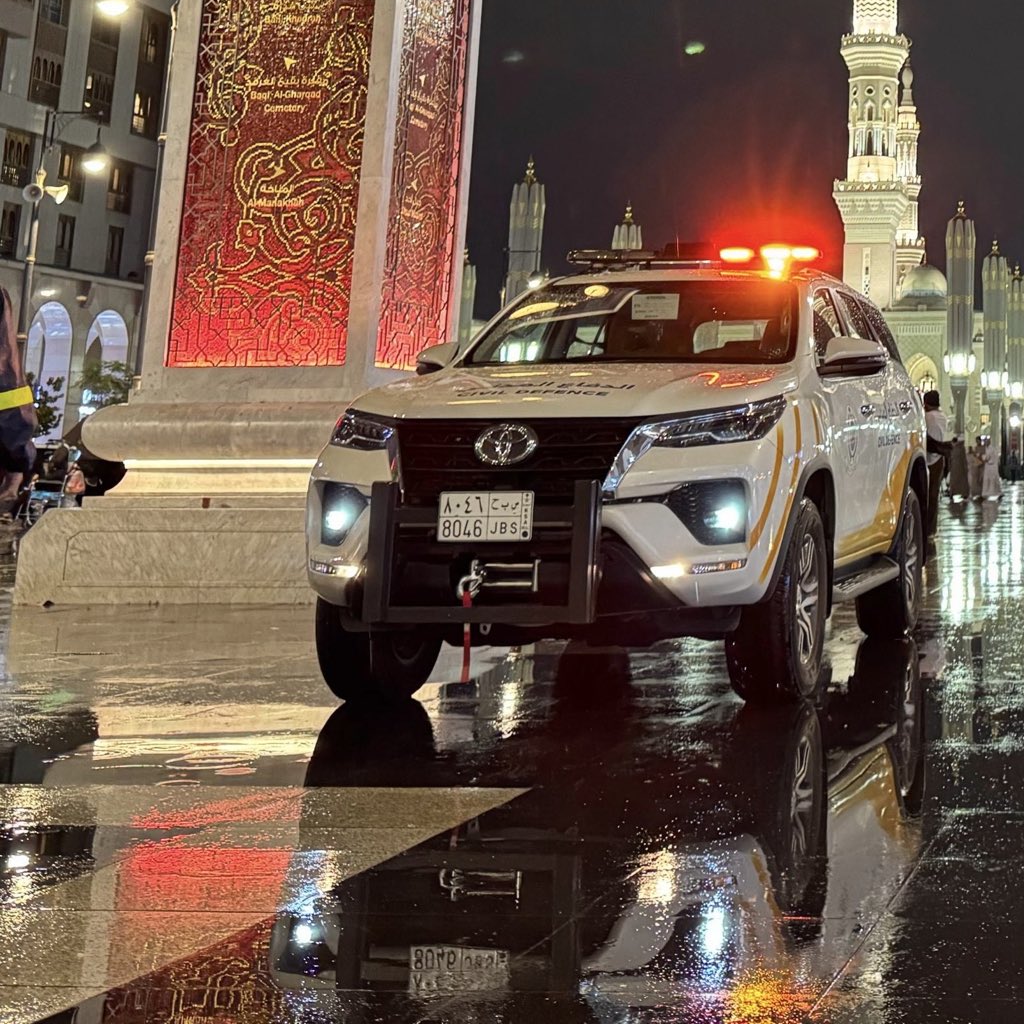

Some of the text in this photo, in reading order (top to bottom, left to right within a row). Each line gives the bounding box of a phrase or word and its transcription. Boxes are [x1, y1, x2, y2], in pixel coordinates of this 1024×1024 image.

[264, 103, 305, 114] Cemetery
[457, 388, 609, 397] CIVIL DEFENCE
[442, 519, 517, 538] 8046 JBS
